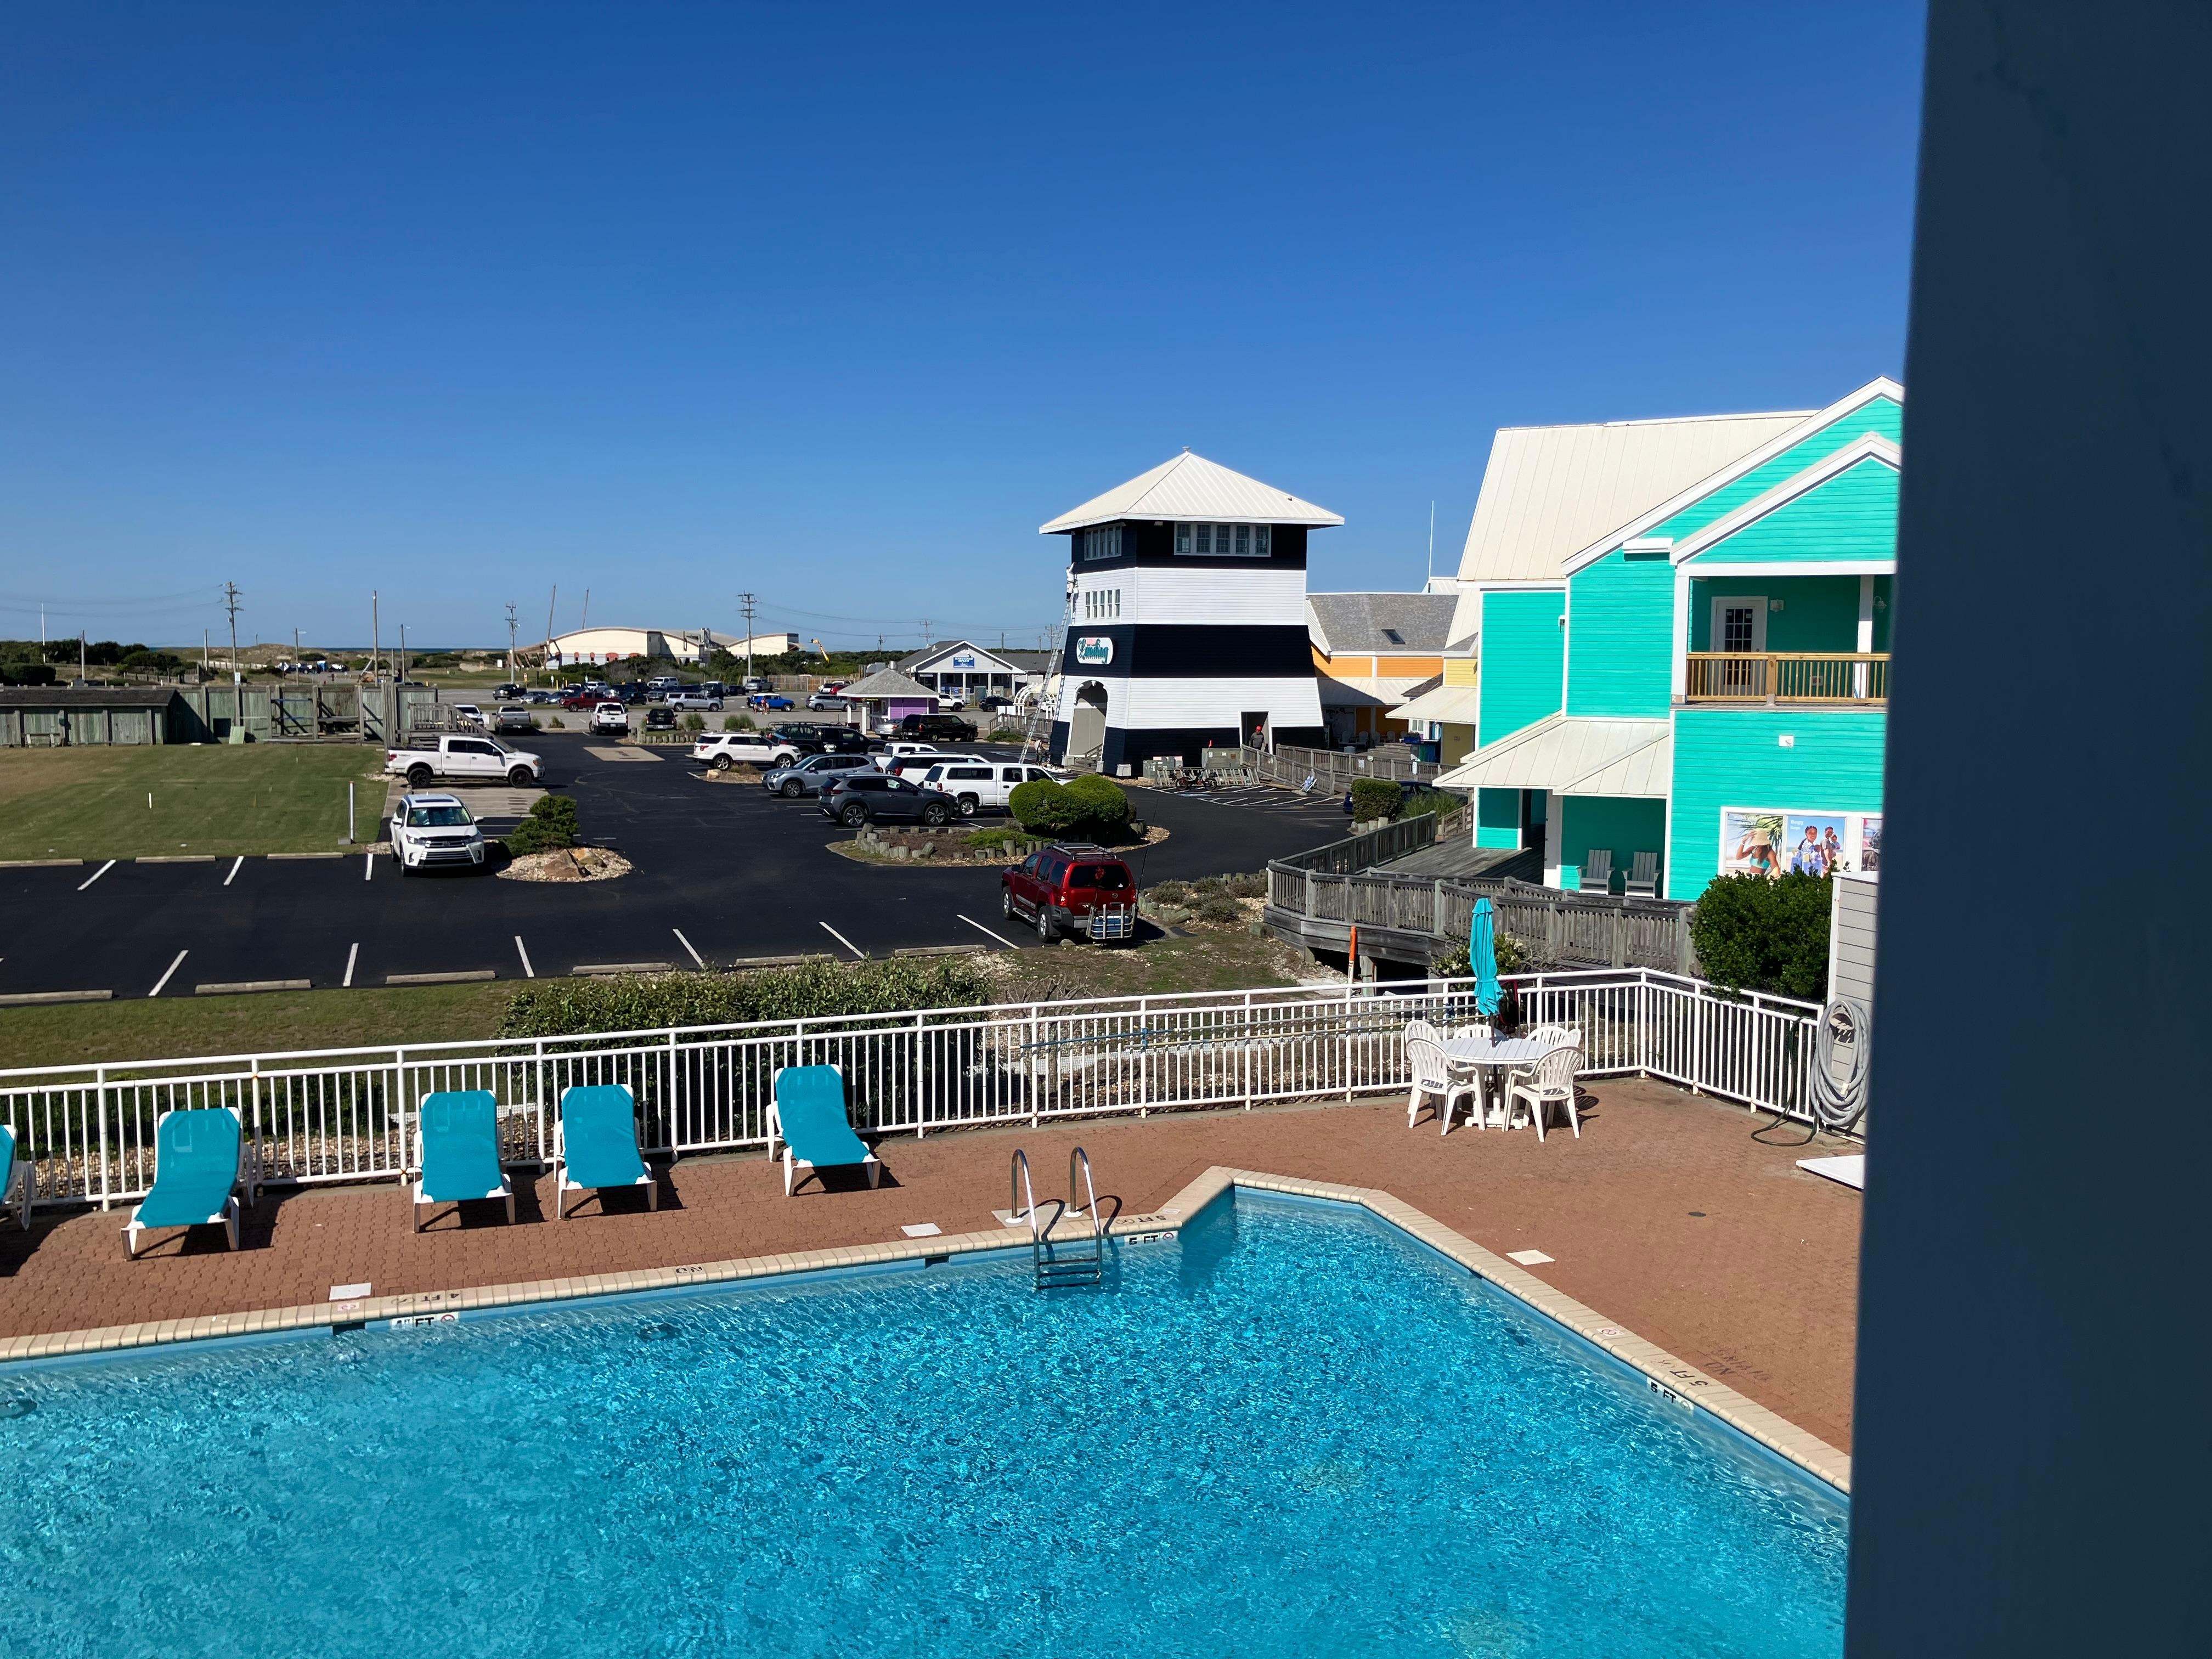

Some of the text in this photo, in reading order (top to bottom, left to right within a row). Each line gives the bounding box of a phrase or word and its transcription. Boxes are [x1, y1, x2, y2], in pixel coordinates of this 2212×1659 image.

[1078, 638, 1109, 664] Landing
[1143, 1235, 1158, 1244] FT
[415, 1317, 435, 1327] FT
[1669, 1370, 1696, 1379] FT
[1650, 1381, 1677, 1404] 5 FT
